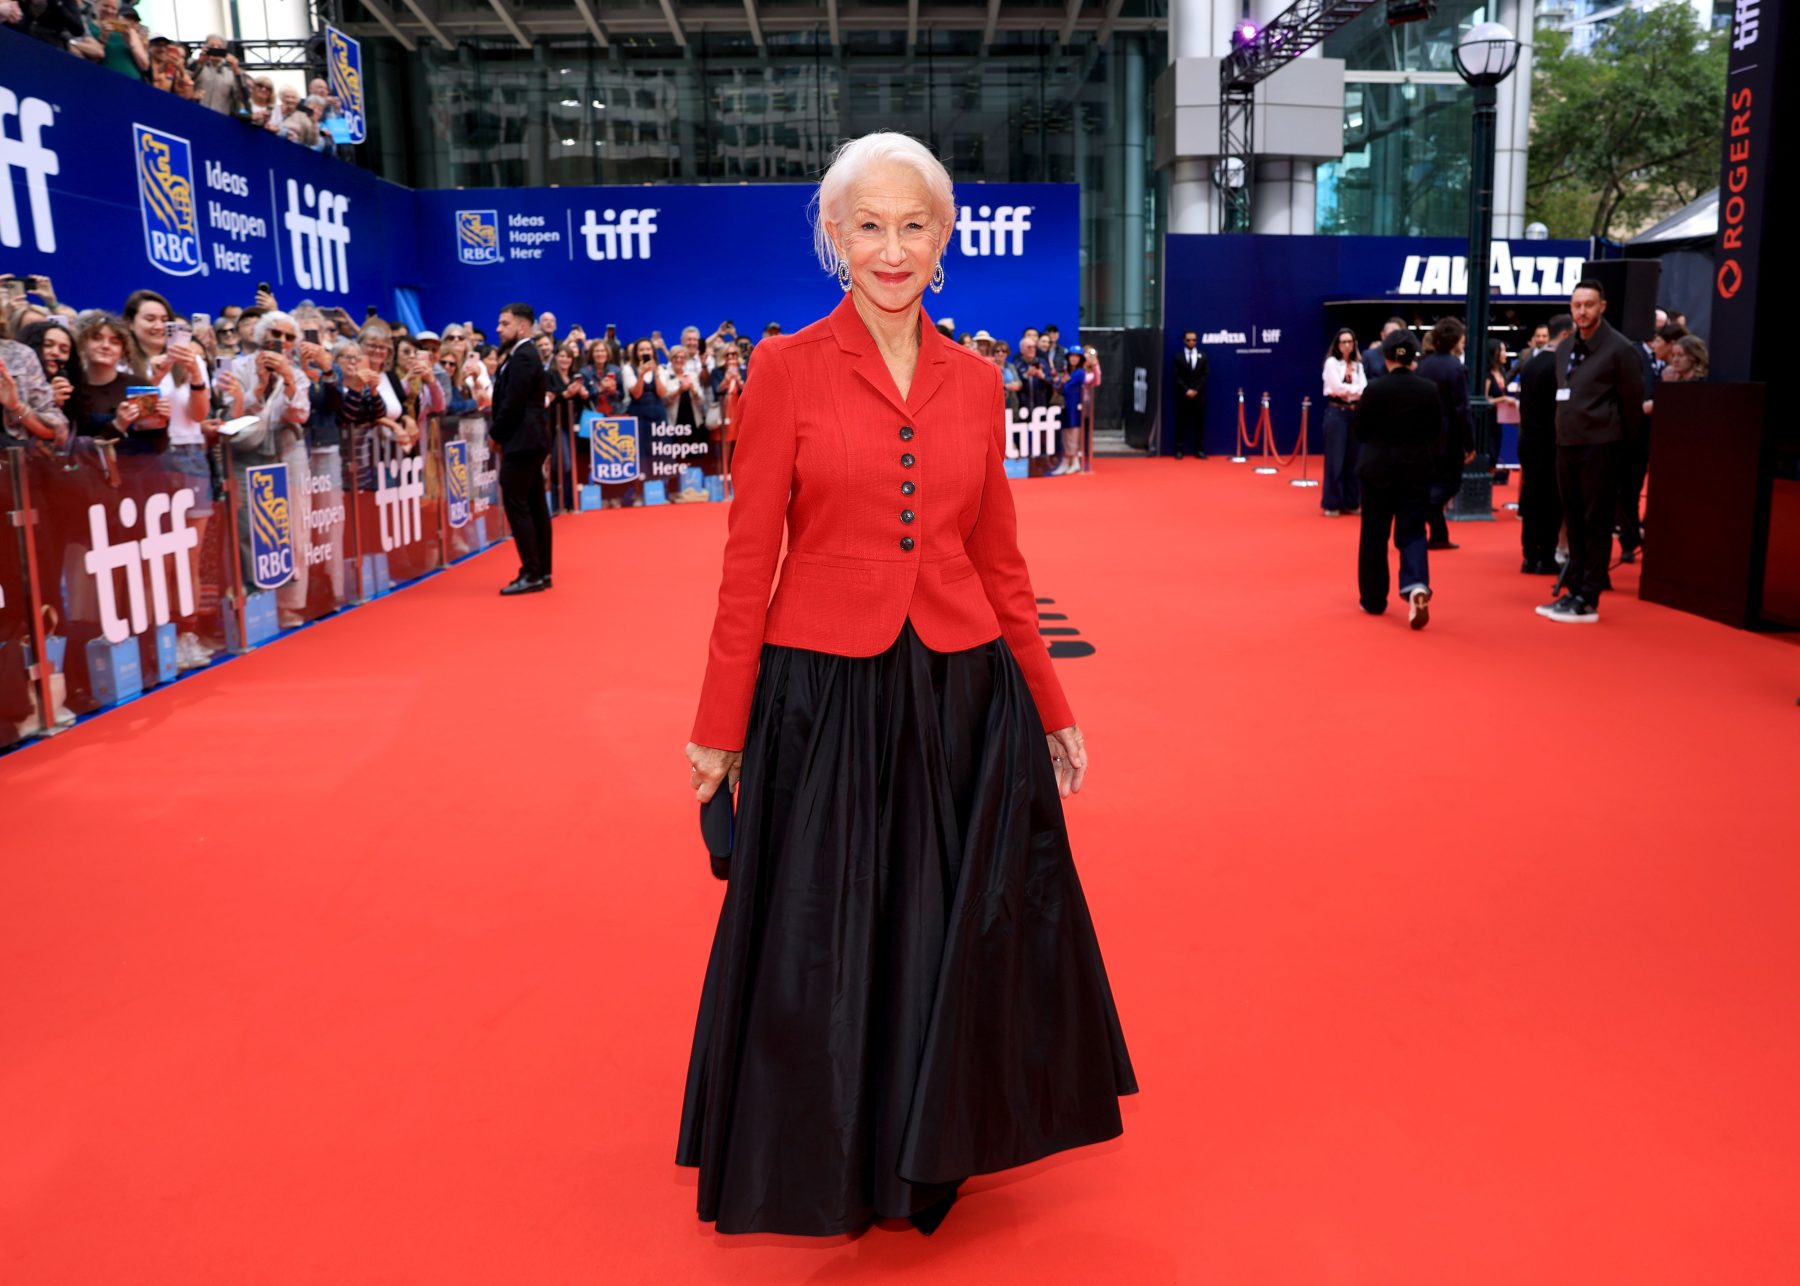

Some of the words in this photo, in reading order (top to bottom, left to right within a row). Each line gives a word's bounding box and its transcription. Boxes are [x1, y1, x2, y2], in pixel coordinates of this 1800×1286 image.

[205, 160, 249, 197] Ideas
[1723, 87, 1752, 249] ROGERS
[208, 200, 267, 242] Happen
[285, 178, 350, 294] tiff
[508, 214, 545, 227] Ideas
[580, 208, 657, 261] tiff
[956, 205, 1031, 256] tiff
[151, 230, 197, 265] RBC
[463, 248, 496, 260] RBC
[509, 231, 560, 246] Happen
[511, 247, 542, 259] Here
[212, 242, 252, 274] Here
[651, 421, 692, 436] Ideas
[1005, 406, 1061, 458] tiff
[652, 442, 708, 459] Happen
[300, 469, 332, 496] Ideas
[597, 462, 635, 478] RBC
[652, 462, 688, 475] Here
[302, 504, 346, 534] Happen
[375, 456, 424, 552] tiff
[451, 500, 468, 519] RBC
[85, 488, 198, 643] tiff
[257, 548, 292, 581] RBC
[304, 542, 333, 566] Here
